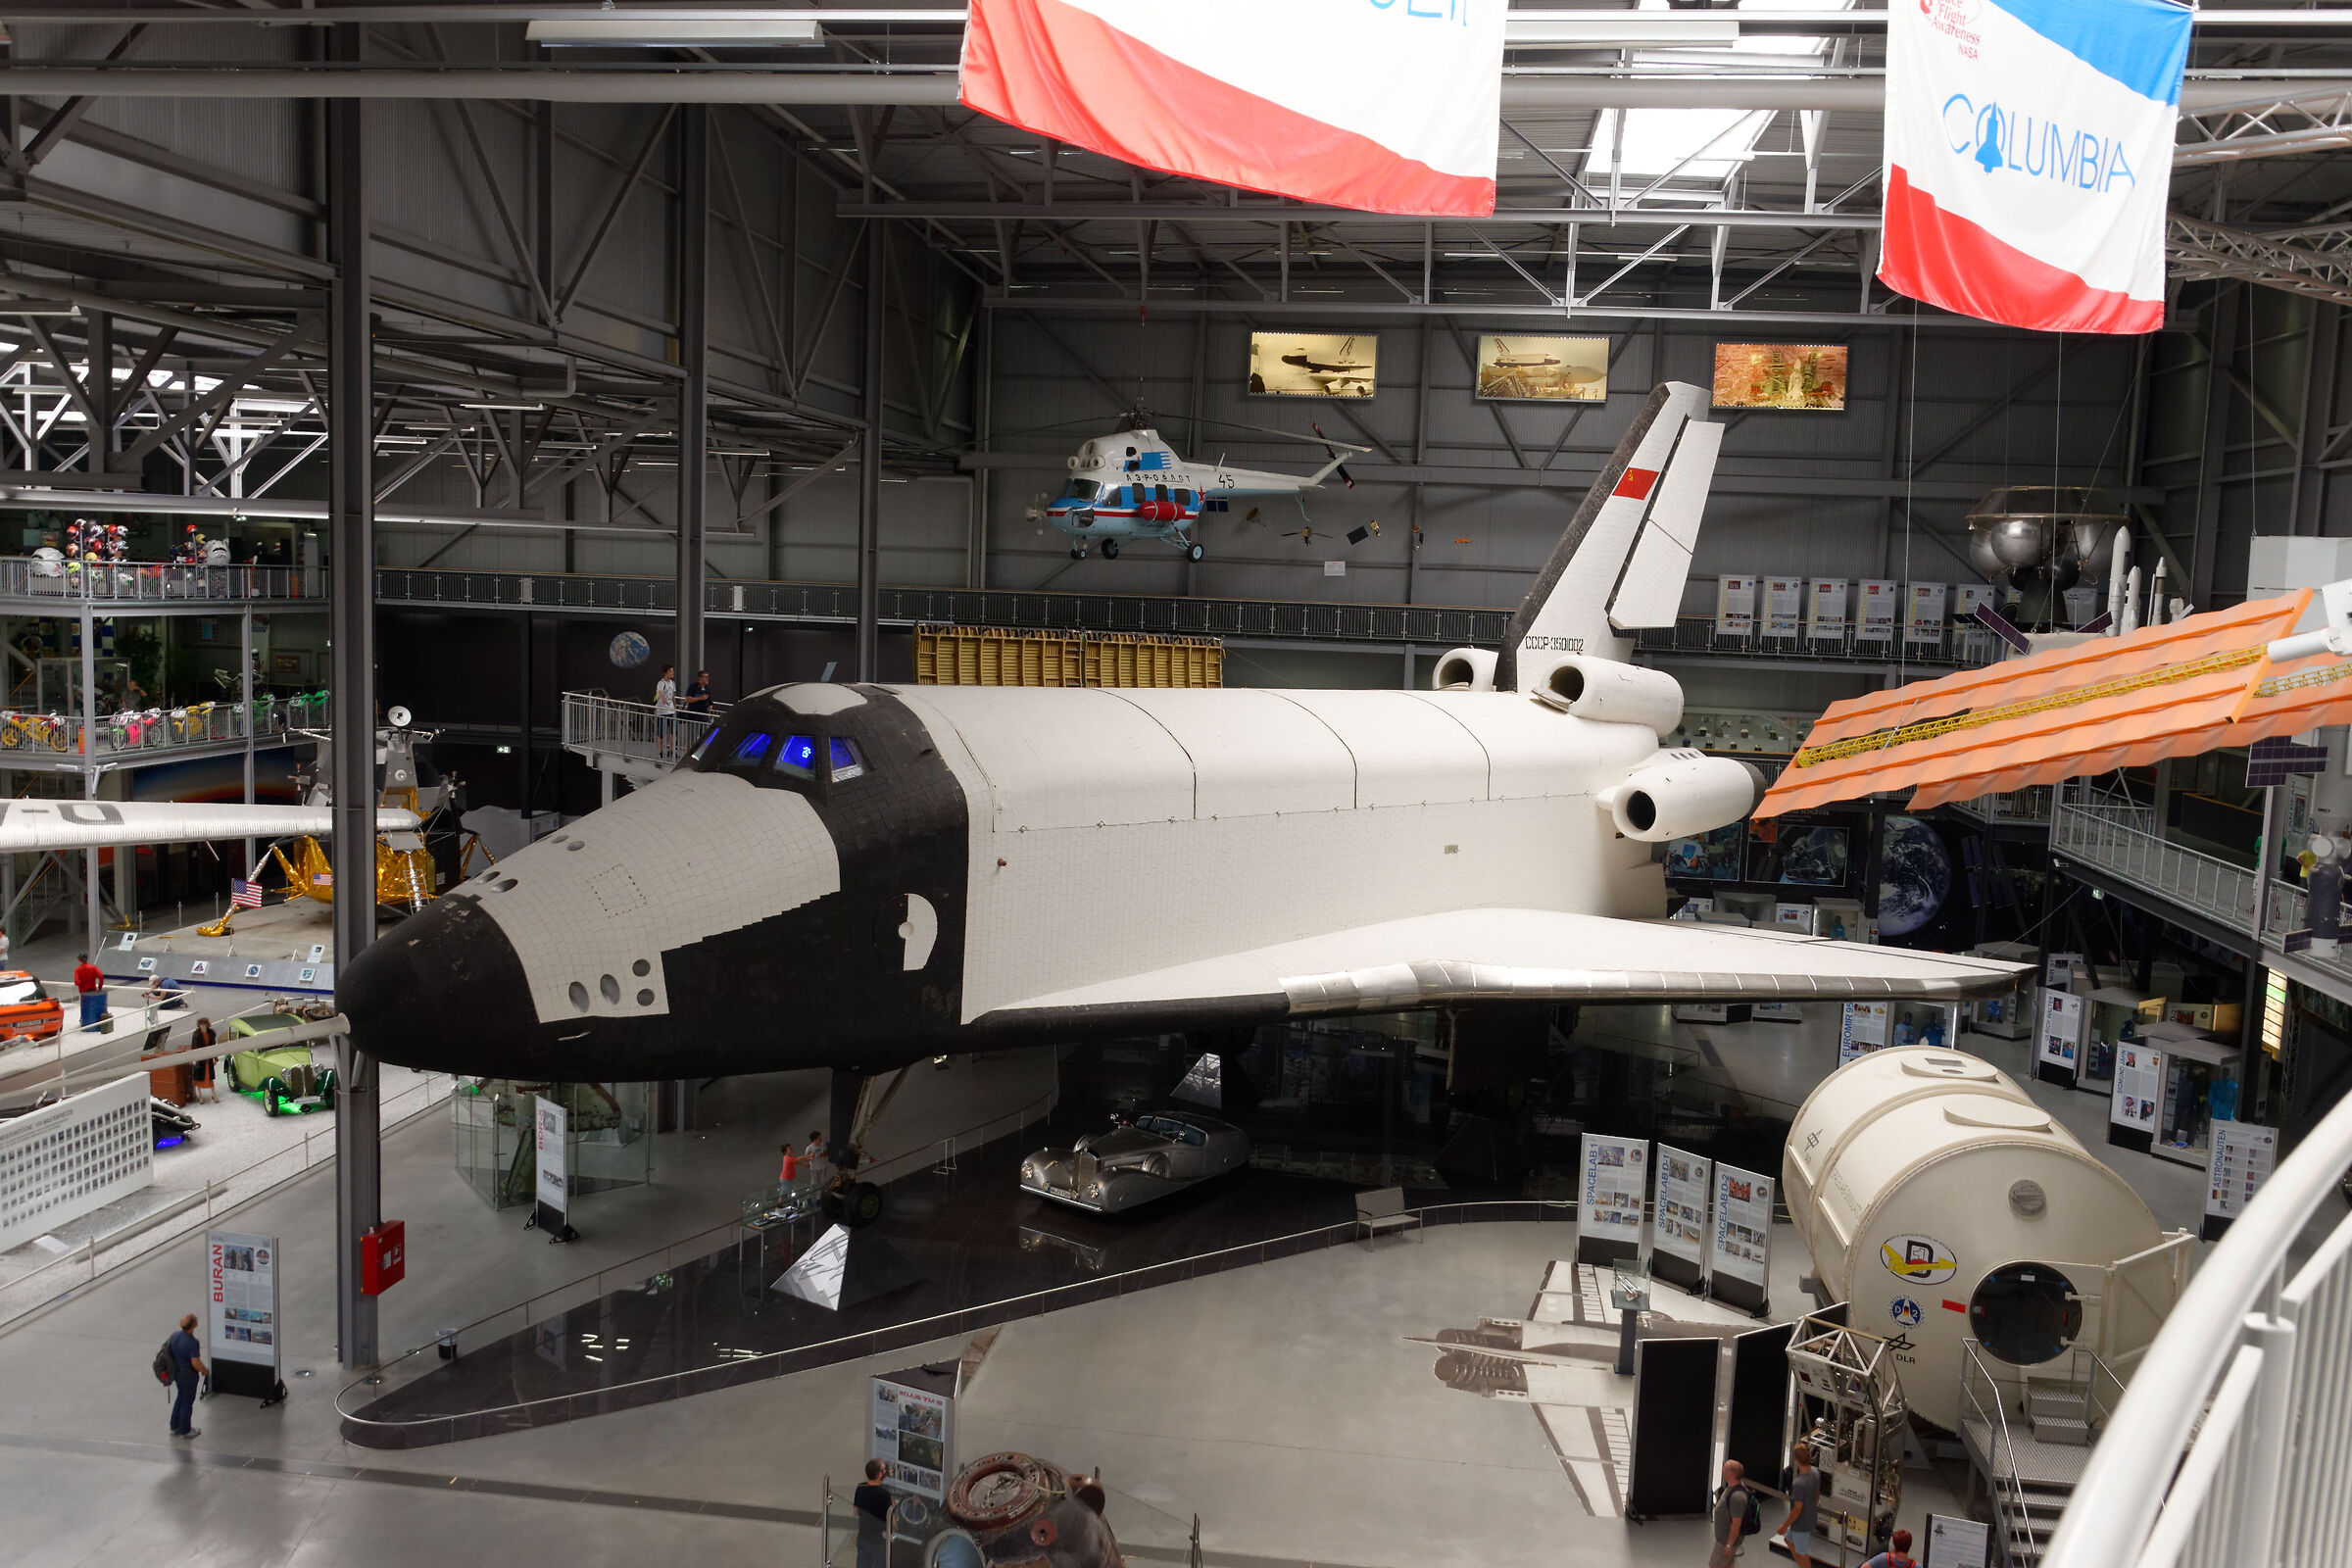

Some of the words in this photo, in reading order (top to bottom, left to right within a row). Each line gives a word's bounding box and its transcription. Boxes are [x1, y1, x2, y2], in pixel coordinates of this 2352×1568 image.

[1937, 4, 1967, 27] Flight
[1932, 16, 1982, 46] Awareness
[1958, 43, 1979, 60] NASA
[1942, 93, 2135, 193] COLUMBIA
[1218, 474, 1235, 489] 45
[1846, 1002, 1854, 1013] 95
[1842, 1013, 1853, 1057] EUROMIR
[2213, 1129, 2226, 1188] ASTRONAUTEN
[1587, 1150, 1598, 1205] SPACELAB
[1721, 1174, 1730, 1192] D-2
[1659, 1172, 1669, 1229] SPACELAB
[1718, 1192, 1729, 1251] SPACELAB
[212, 1244, 224, 1302] BURAN
[1912, 1309, 1919, 1319] 2
[1895, 1353, 1916, 1364] DLR
